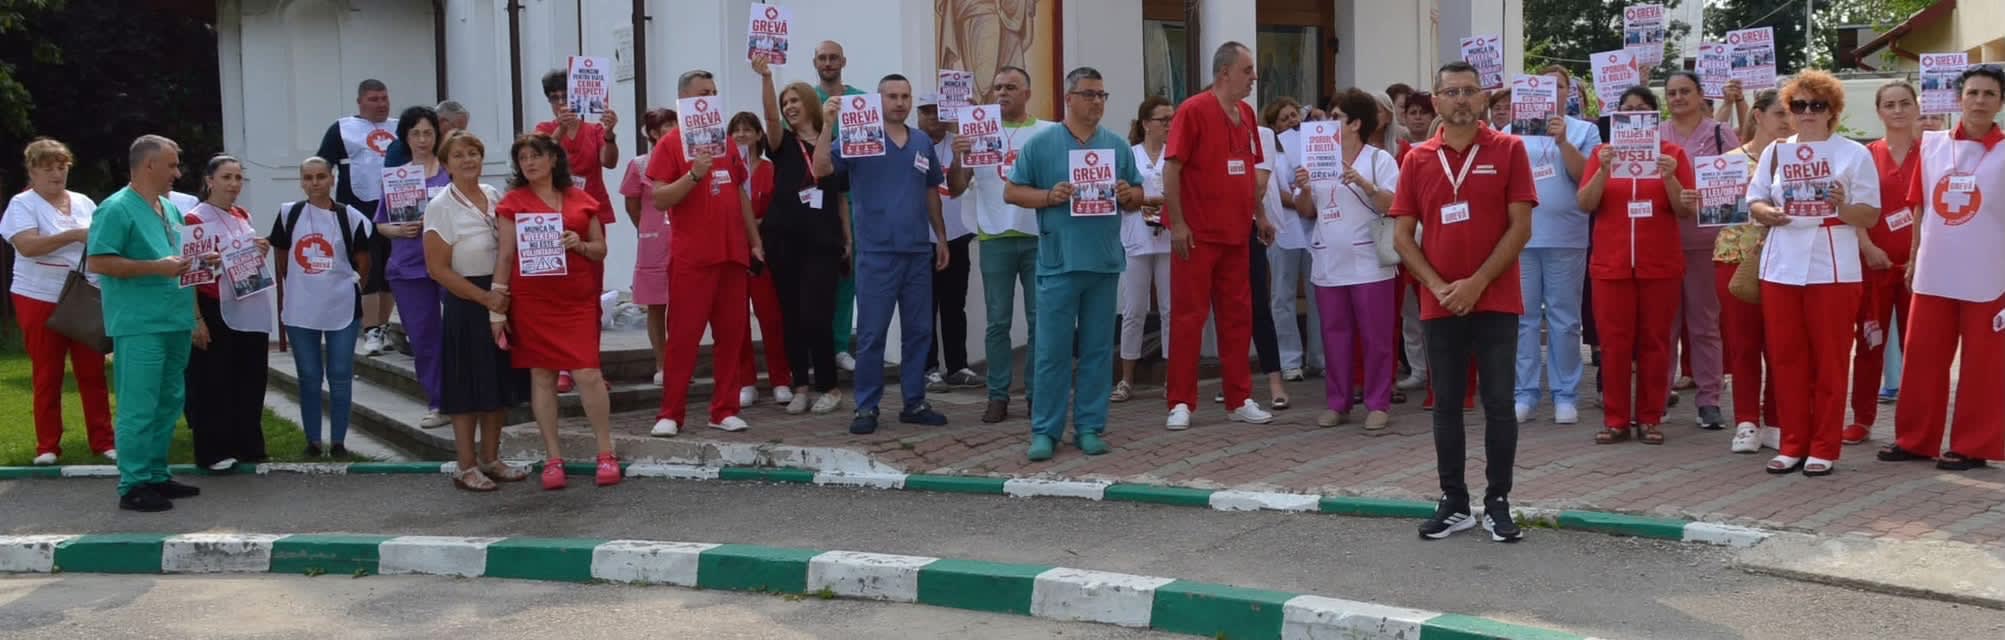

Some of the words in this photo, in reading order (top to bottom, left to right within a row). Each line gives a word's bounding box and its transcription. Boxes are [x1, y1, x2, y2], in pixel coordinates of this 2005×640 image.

[753, 20, 787, 33] GREVĂ
[685, 108, 721, 127] GREVĂ
[842, 107, 879, 125] GREVĂ
[963, 118, 998, 135] GREVĂ
[1073, 163, 1112, 181] GREVĂ
[1783, 158, 1831, 178] GREVĂ
[184, 235, 211, 256] GREVĂ
